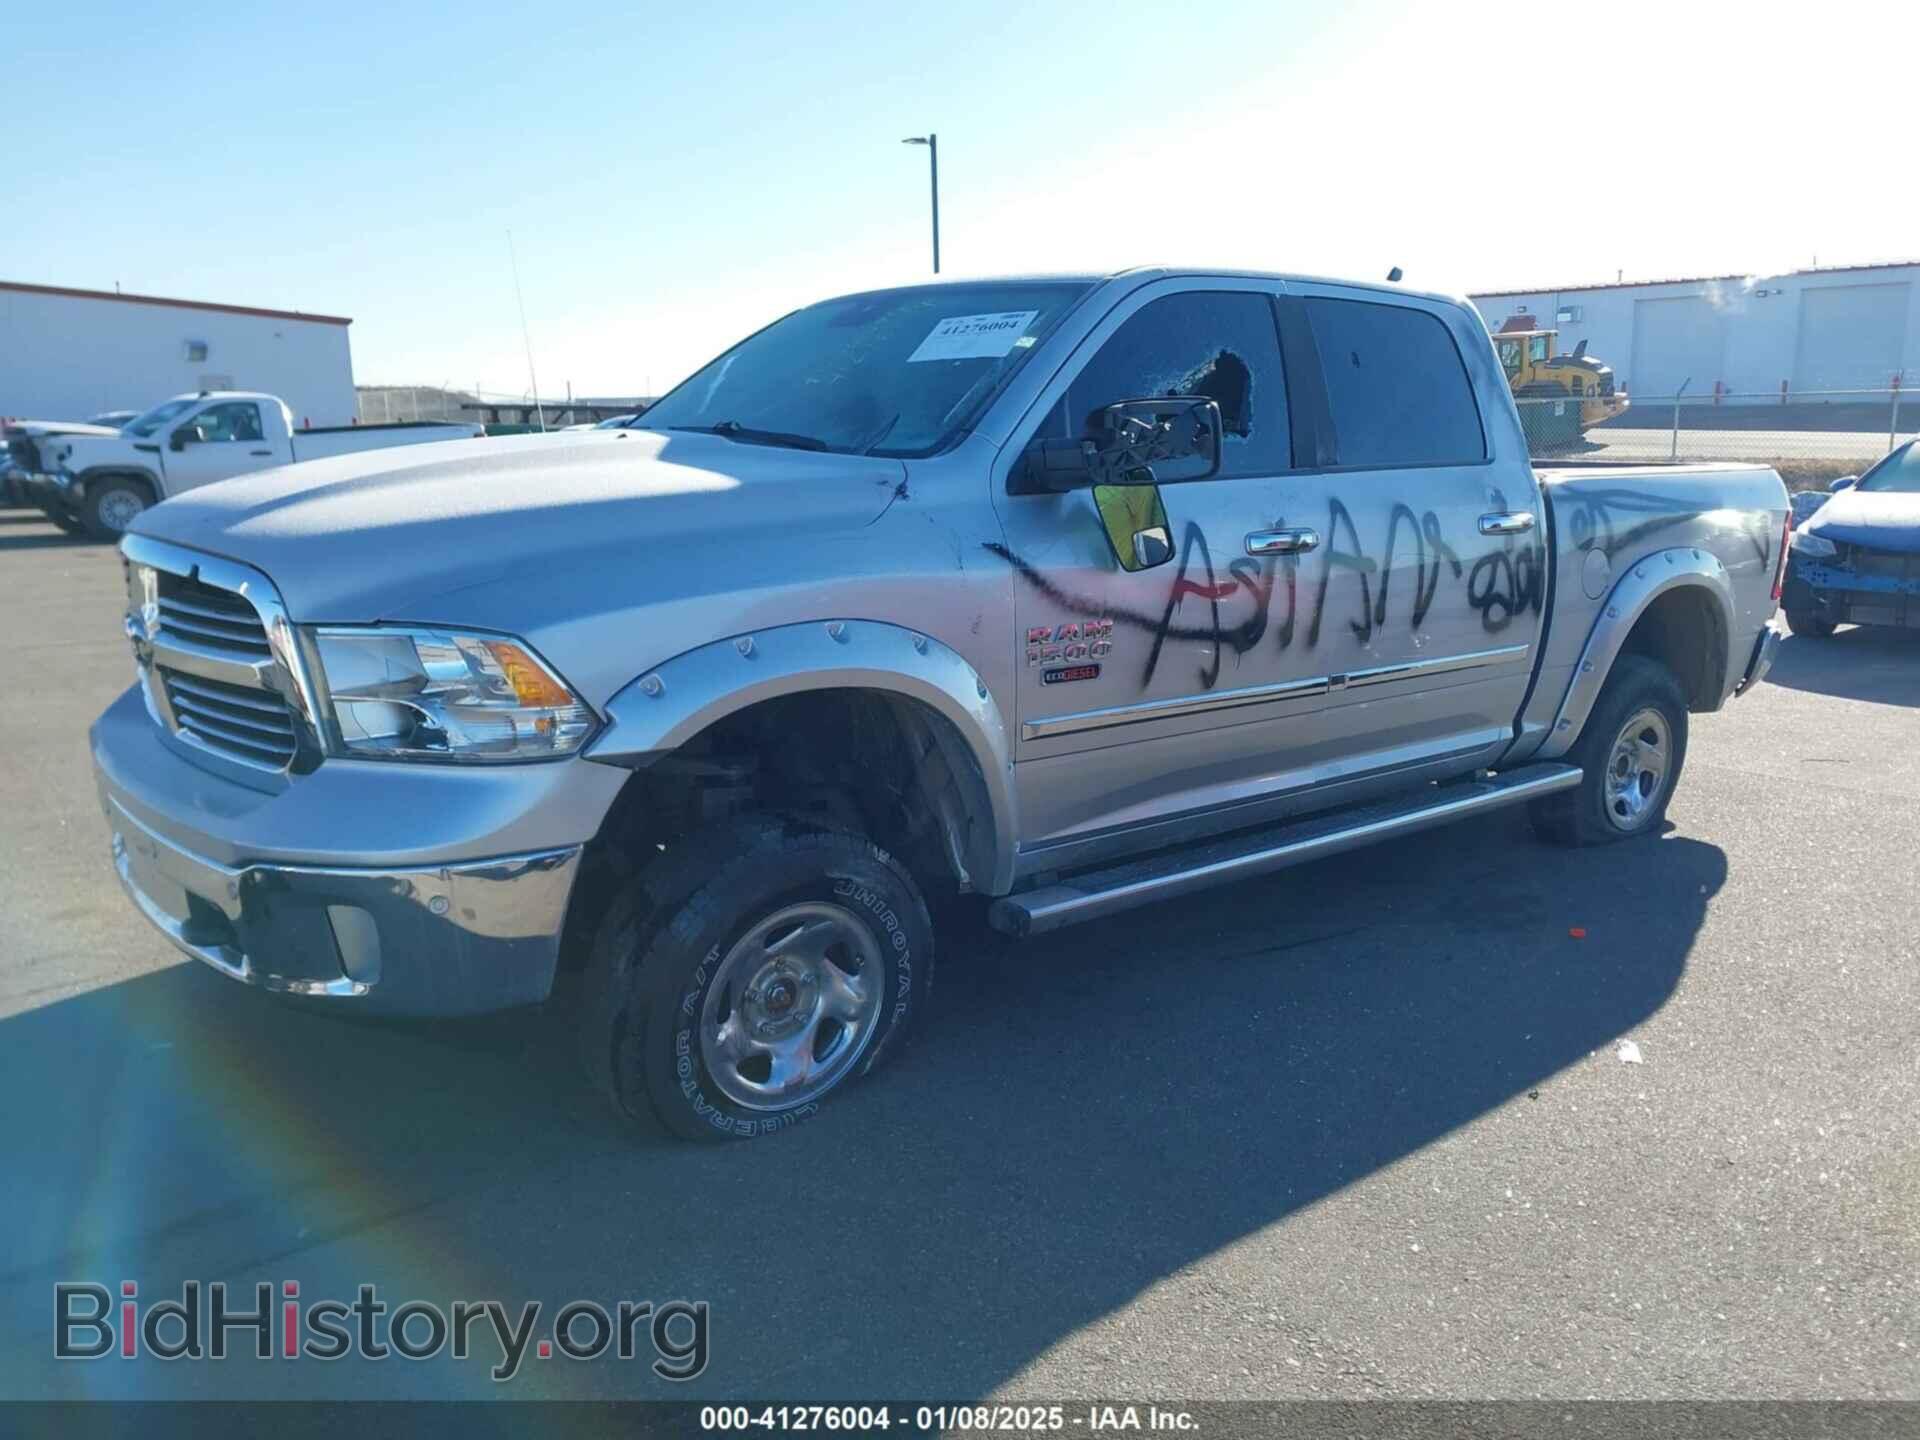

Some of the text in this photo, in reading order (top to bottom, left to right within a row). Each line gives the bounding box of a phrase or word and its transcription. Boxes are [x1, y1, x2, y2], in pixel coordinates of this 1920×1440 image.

[941, 319, 1019, 335] 41276004
[1026, 618, 1113, 644] RAM
[1026, 640, 1113, 667] 1500
[832, 879, 912, 1018] UNIROYAL
[676, 943, 819, 1137] LIBERATOR A/T
